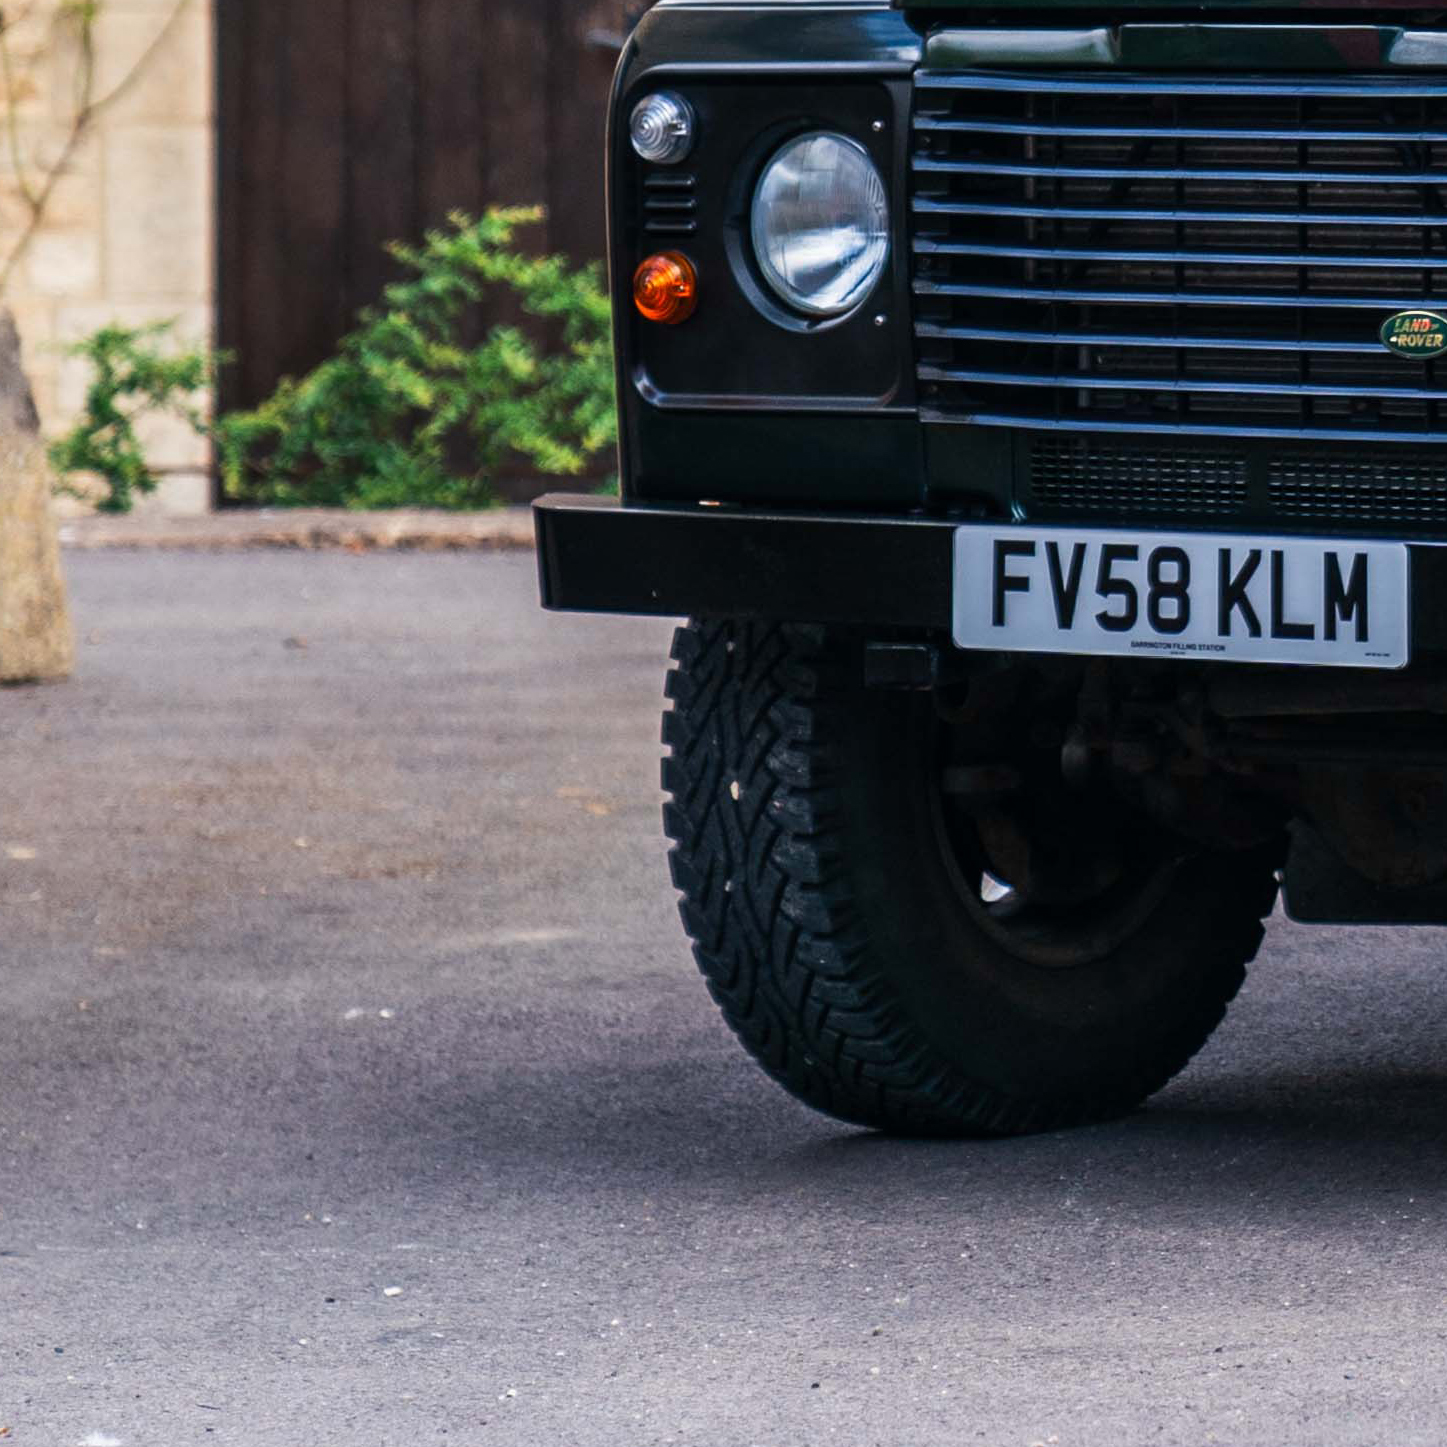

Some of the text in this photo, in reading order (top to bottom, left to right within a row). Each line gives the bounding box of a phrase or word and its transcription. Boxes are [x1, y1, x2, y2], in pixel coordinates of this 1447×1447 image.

[1394, 318, 1431, 333] LAND
[1397, 334, 1443, 347] ROVER
[992, 539, 1369, 643] FV58 KLM
[1198, 643, 1226, 652] STATION
